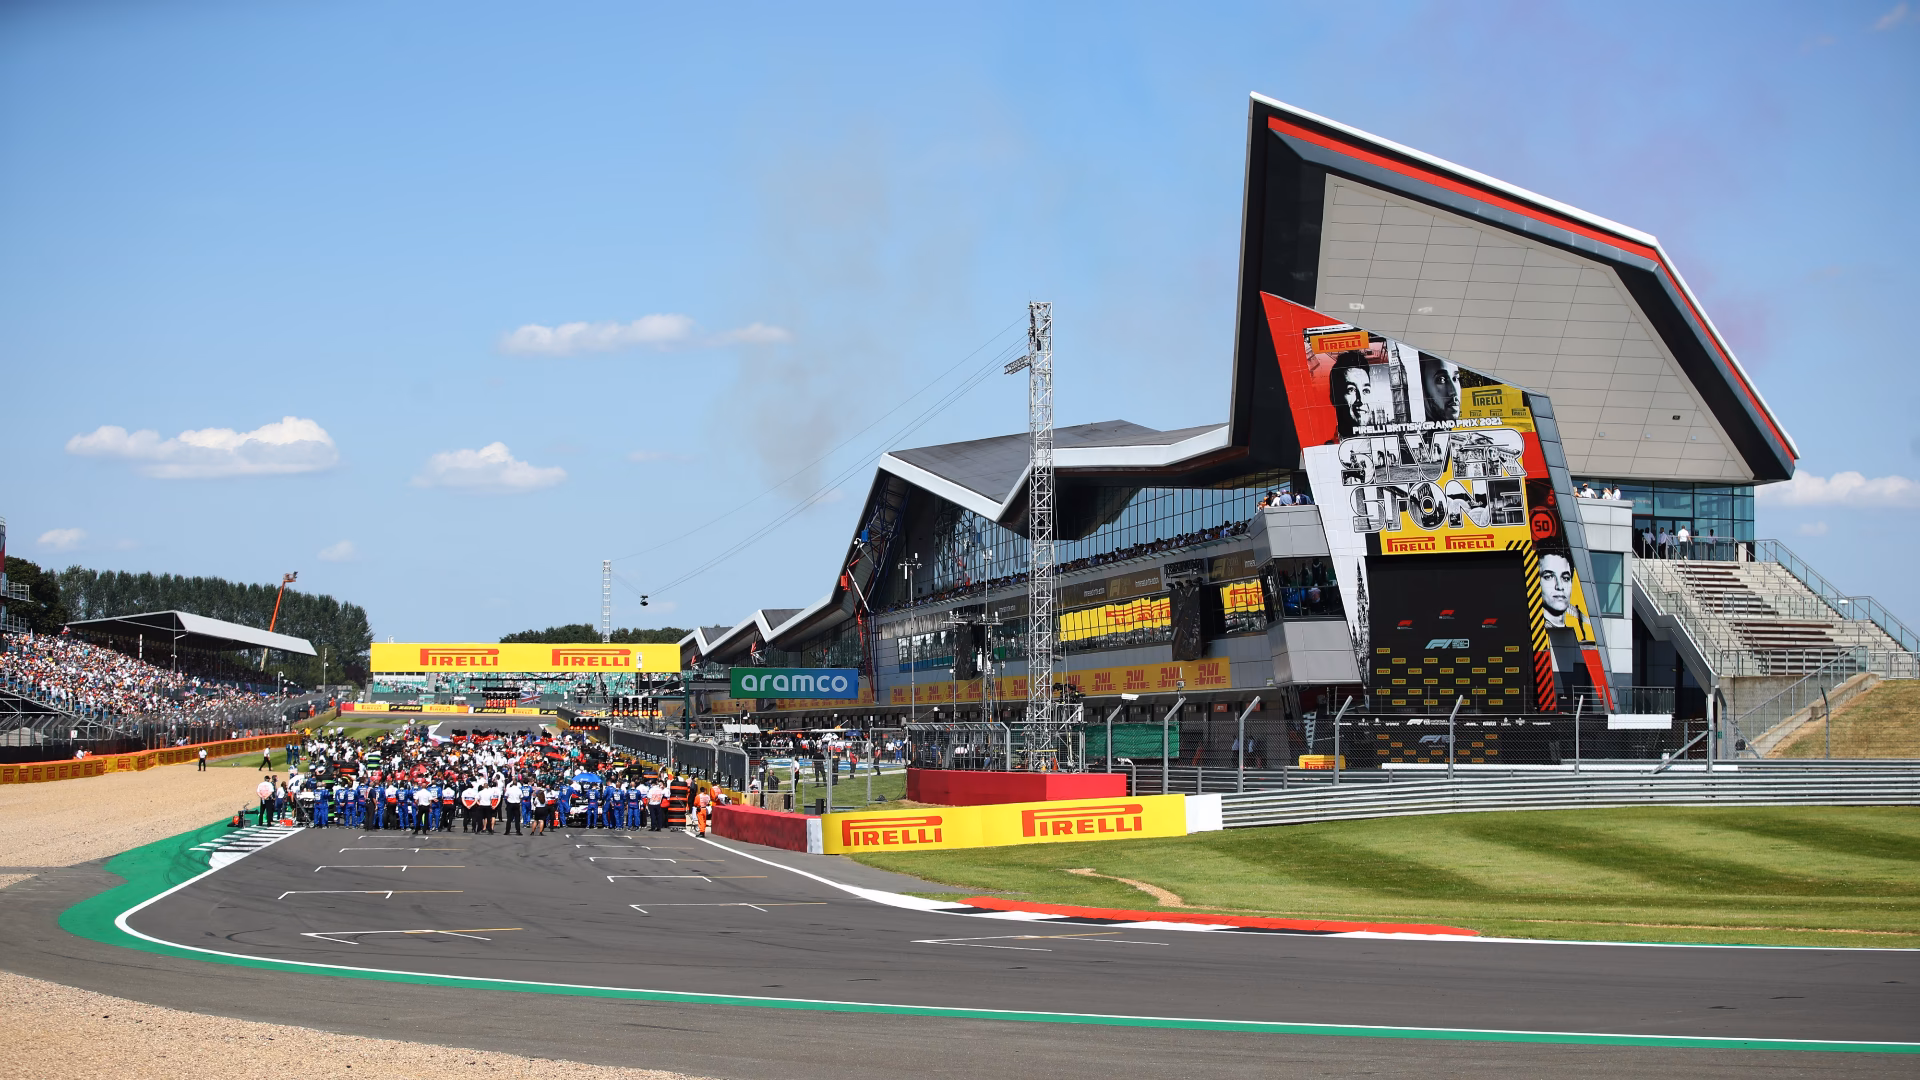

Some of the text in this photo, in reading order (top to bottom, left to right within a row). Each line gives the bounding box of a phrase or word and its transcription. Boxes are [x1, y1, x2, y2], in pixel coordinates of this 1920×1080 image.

[1318, 335, 1361, 350] PIRELLI
[1472, 389, 1502, 406] PIRELLI
[1352, 417, 1503, 434] PIRELLI BRITISH GRAND PRIX 2021
[1338, 428, 1527, 486] SILVER
[1350, 477, 1526, 533] STONE
[1534, 520, 1550, 532] 50
[1387, 534, 1494, 552] PIRELLI PIRELLI
[420, 648, 631, 666] PIRELLI PIRELLI
[741, 675, 848, 692] aramco
[1094, 672, 1114, 691] DHL
[1125, 670, 1147, 689] DHL
[1197, 662, 1223, 685] DHL
[842, 803, 1144, 846] PIRELLI PIRELLI
